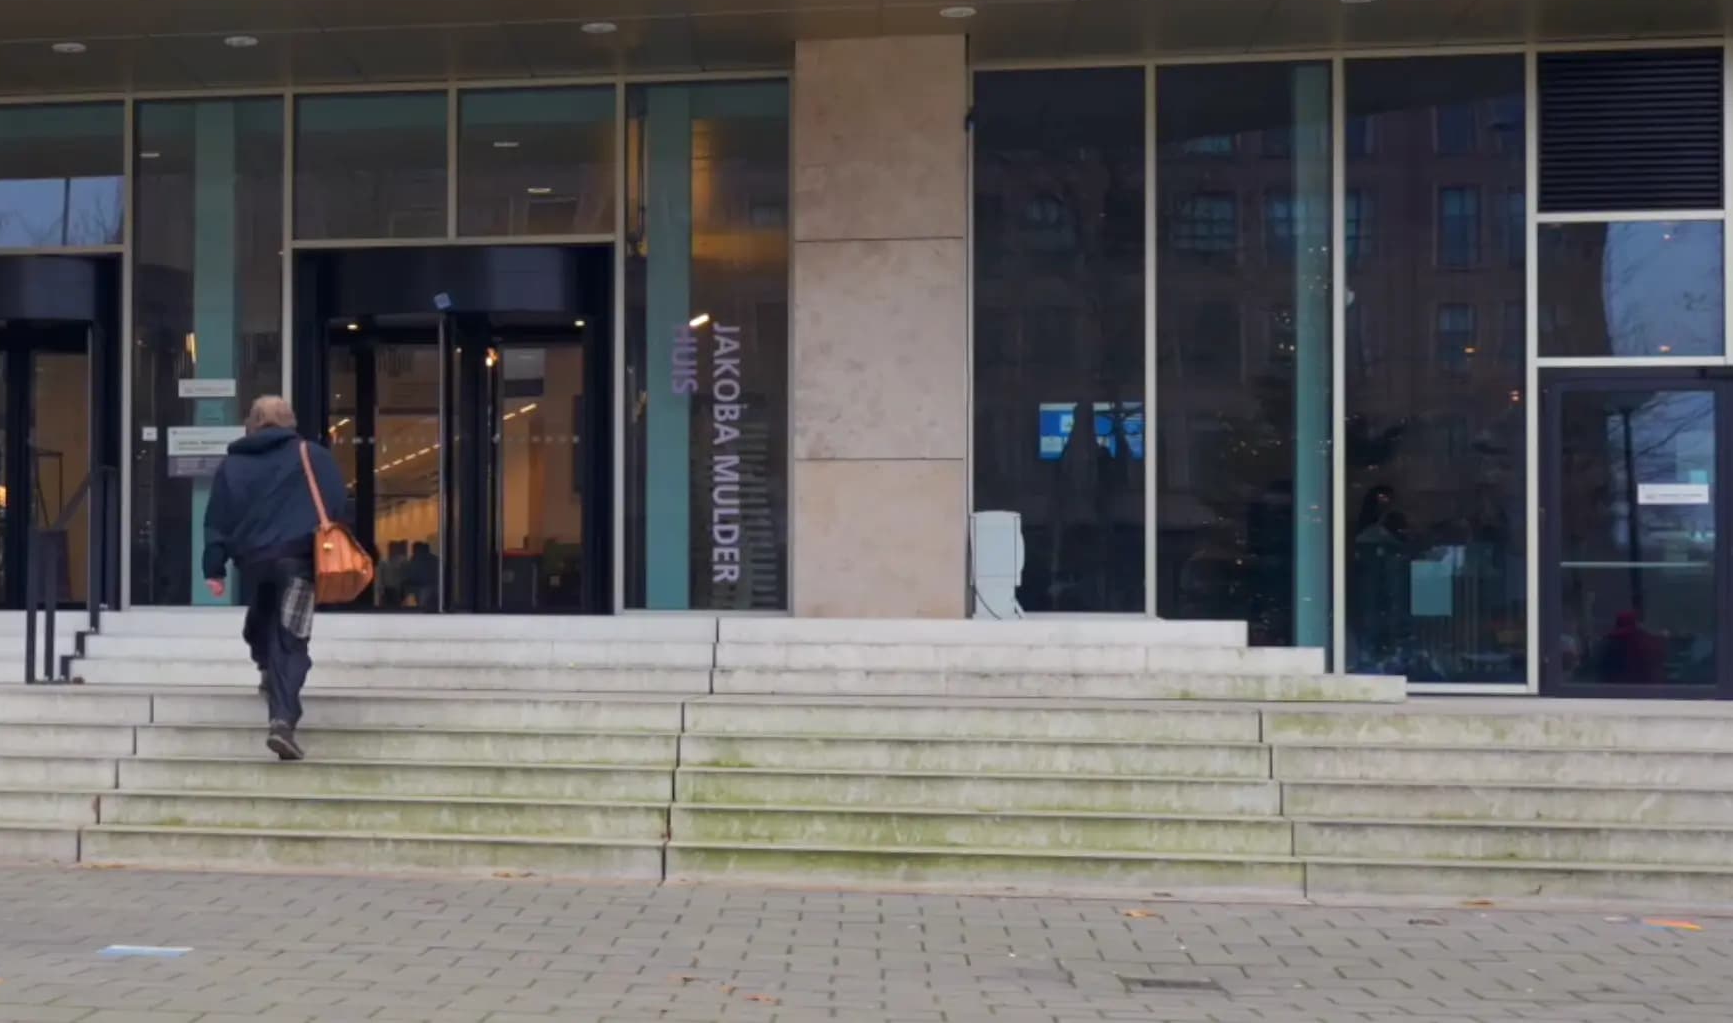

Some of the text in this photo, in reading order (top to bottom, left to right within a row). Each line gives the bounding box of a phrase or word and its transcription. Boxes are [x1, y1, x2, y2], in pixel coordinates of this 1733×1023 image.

[671, 325, 698, 395] HUIS
[711, 321, 741, 583] JAKOBA MULDER
